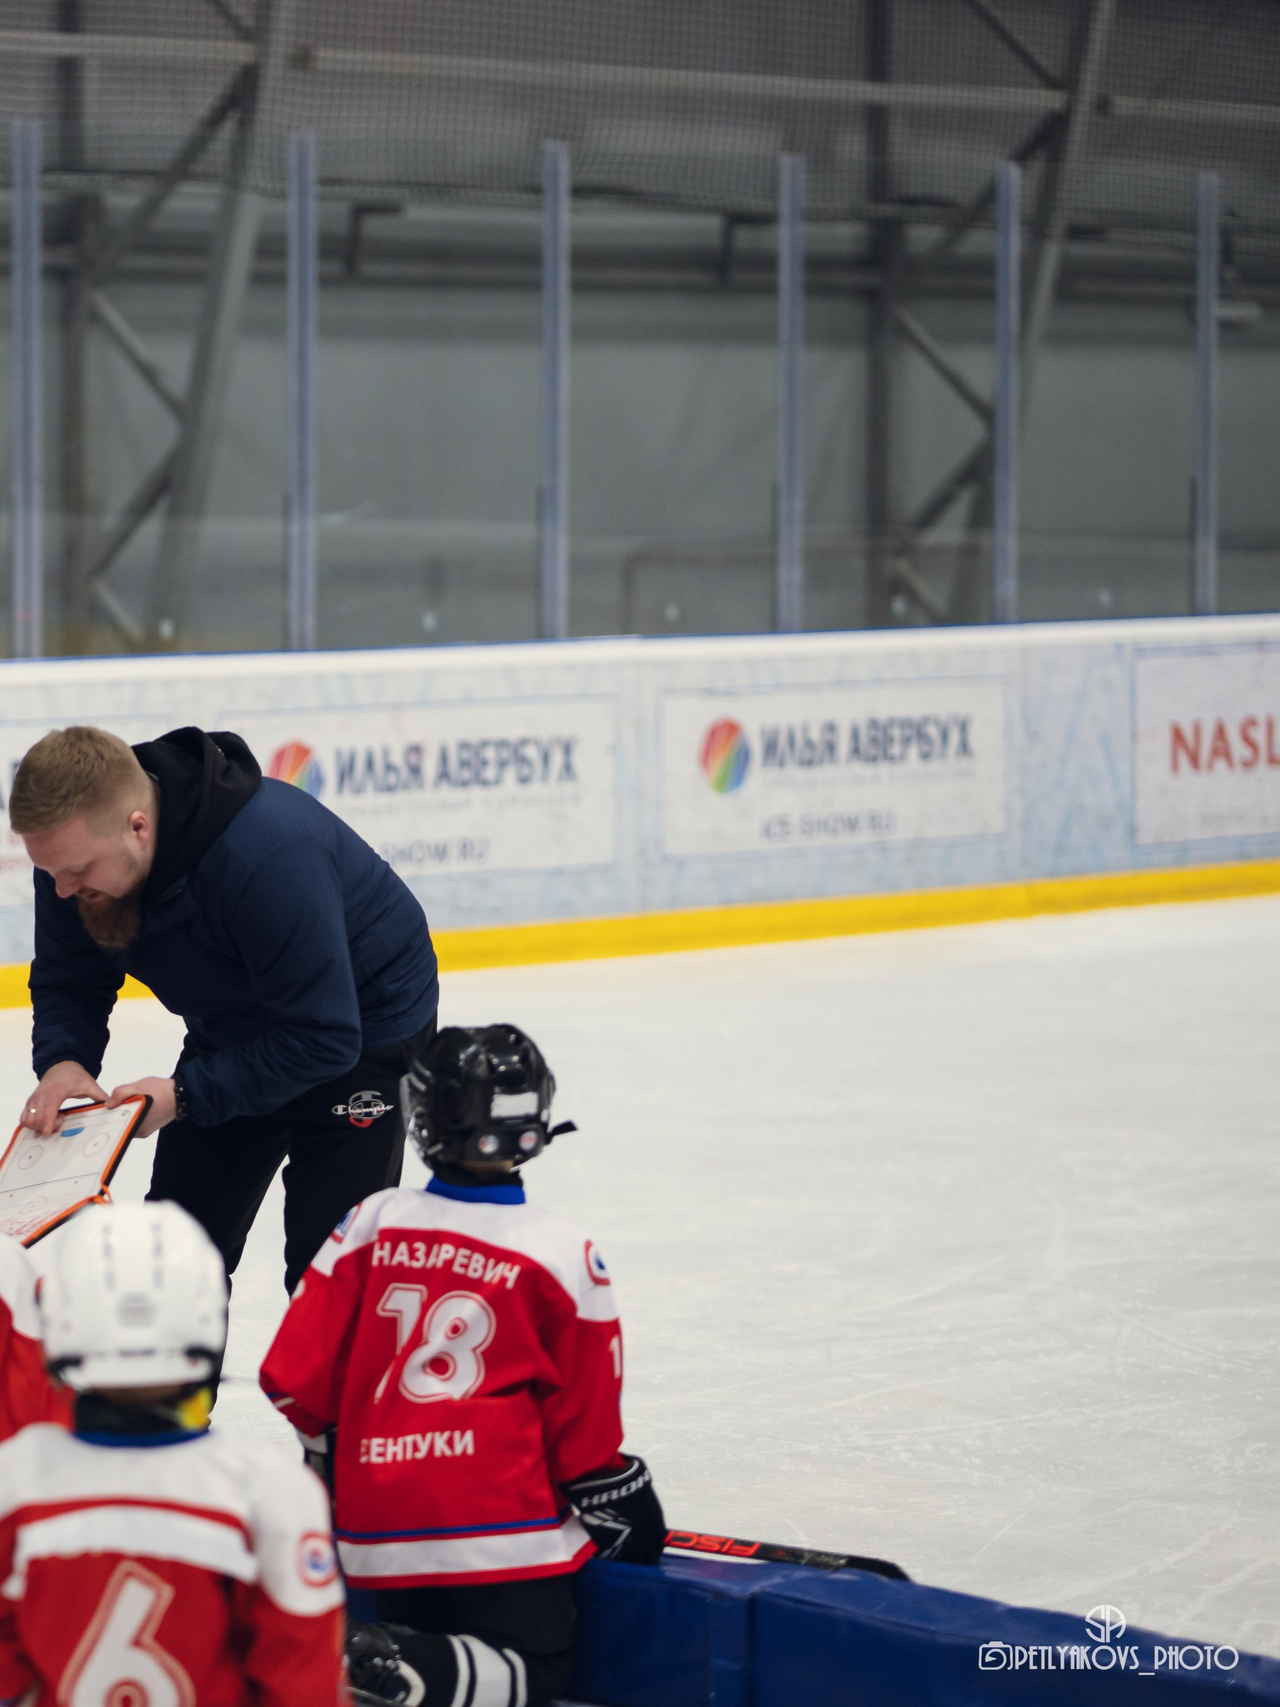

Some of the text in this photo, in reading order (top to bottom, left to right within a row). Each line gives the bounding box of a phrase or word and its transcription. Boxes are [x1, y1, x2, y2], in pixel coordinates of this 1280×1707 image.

[334, 733, 578, 797] ИЛЬЯ АВЕРБУХ
[761, 713, 974, 769] ИЛЬЯ АВЕРБУХ
[376, 1282, 497, 1405] 18
[56, 1558, 197, 1707] 6
